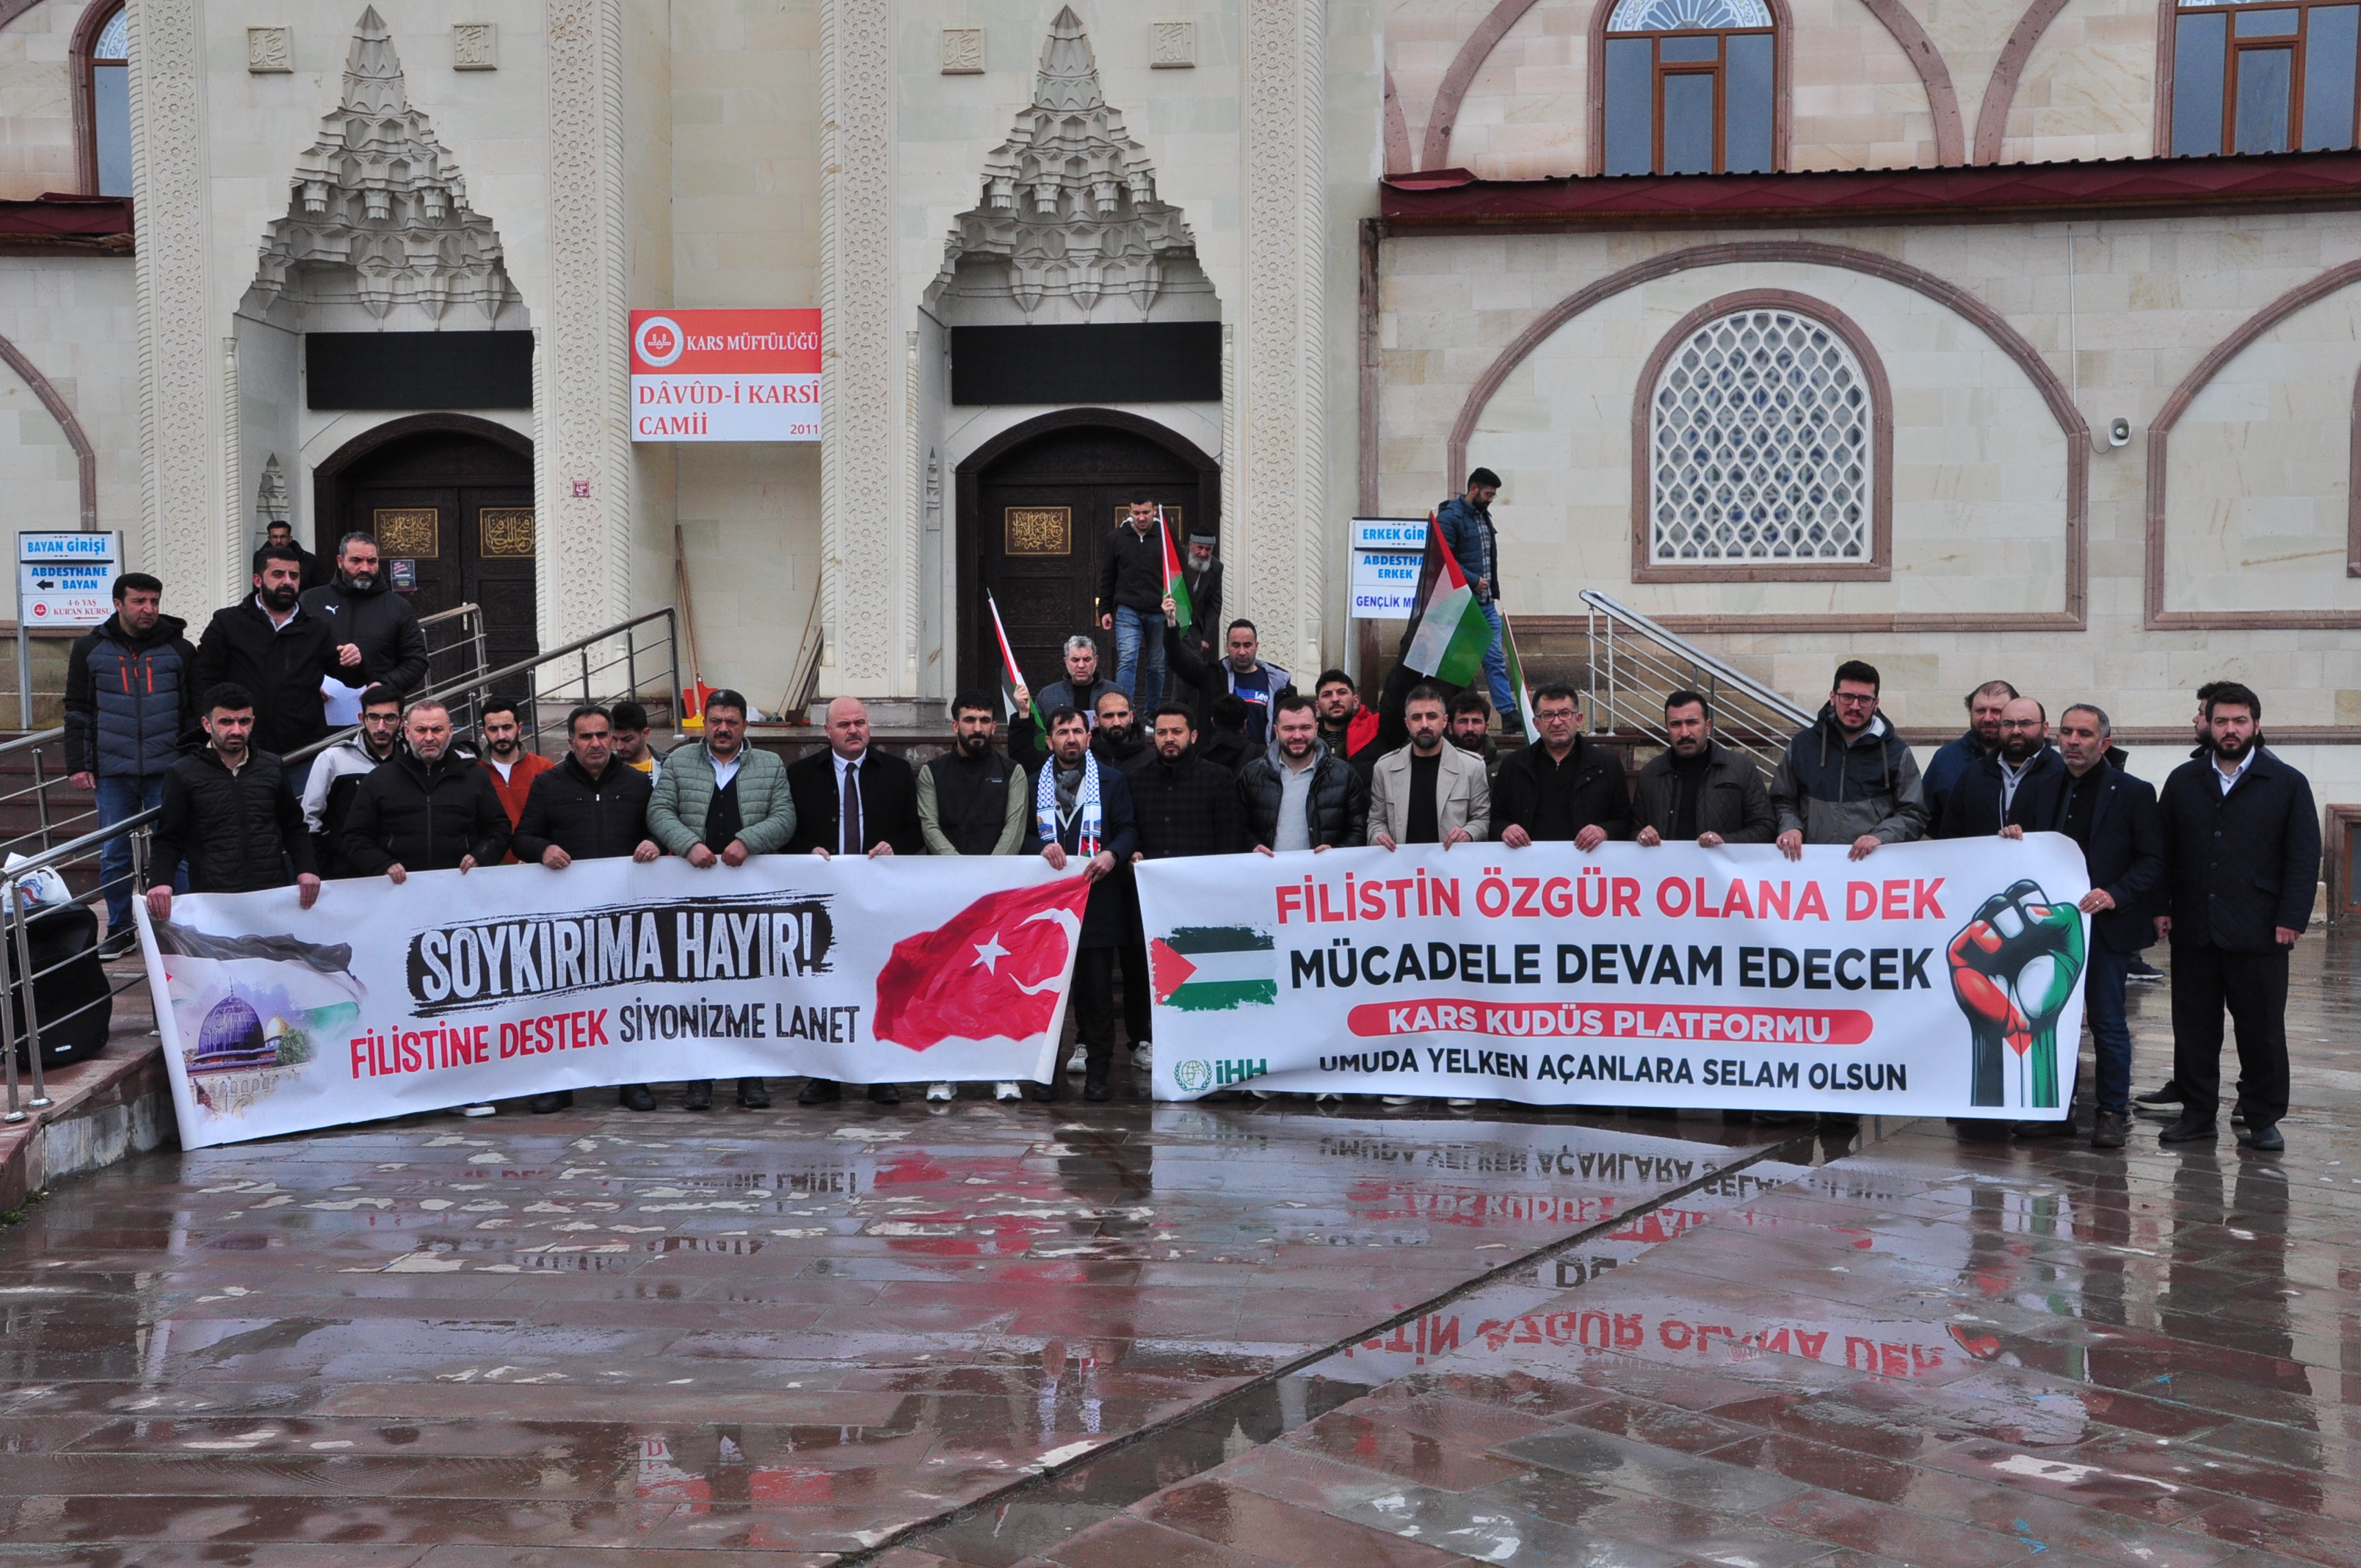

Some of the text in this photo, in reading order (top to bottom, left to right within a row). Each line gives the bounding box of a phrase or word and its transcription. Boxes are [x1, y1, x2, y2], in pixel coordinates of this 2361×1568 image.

[687, 332, 819, 350] KARS MÜFTÜLÜĞÜ
[639, 380, 820, 404] DÂVÛD-İ KARSÎ
[639, 412, 708, 435] CAMİİ
[790, 424, 819, 435] 2011
[1363, 529, 1401, 540] ERKEK
[27, 537, 106, 555] BAYAN GİRİŞİ
[32, 567, 108, 576] ABDESTHANE
[1378, 569, 1413, 578] ERKEK
[62, 580, 98, 589] BAYAN
[81, 599, 97, 607] YAŞ
[1356, 595, 1400, 610] GENÇLİK
[1255, 691, 1269, 703] Lee
[1275, 866, 1946, 924] FİLİSTİN ÖZGÜR OLANA DEK
[420, 912, 813, 1001] SOYKIRIMA HAYIR!
[1291, 938, 1934, 991] MÜCADELE DEVAM EDECEK
[1388, 1003, 1830, 1042] KARS KUDÜS PLATFORMU
[350, 997, 860, 1079] FİLİSTİNE DESTEK SİYONİZME LANET
[1320, 1048, 1907, 1091] UMUDA YELKEN AÇANLARA SELAM OLSUN
